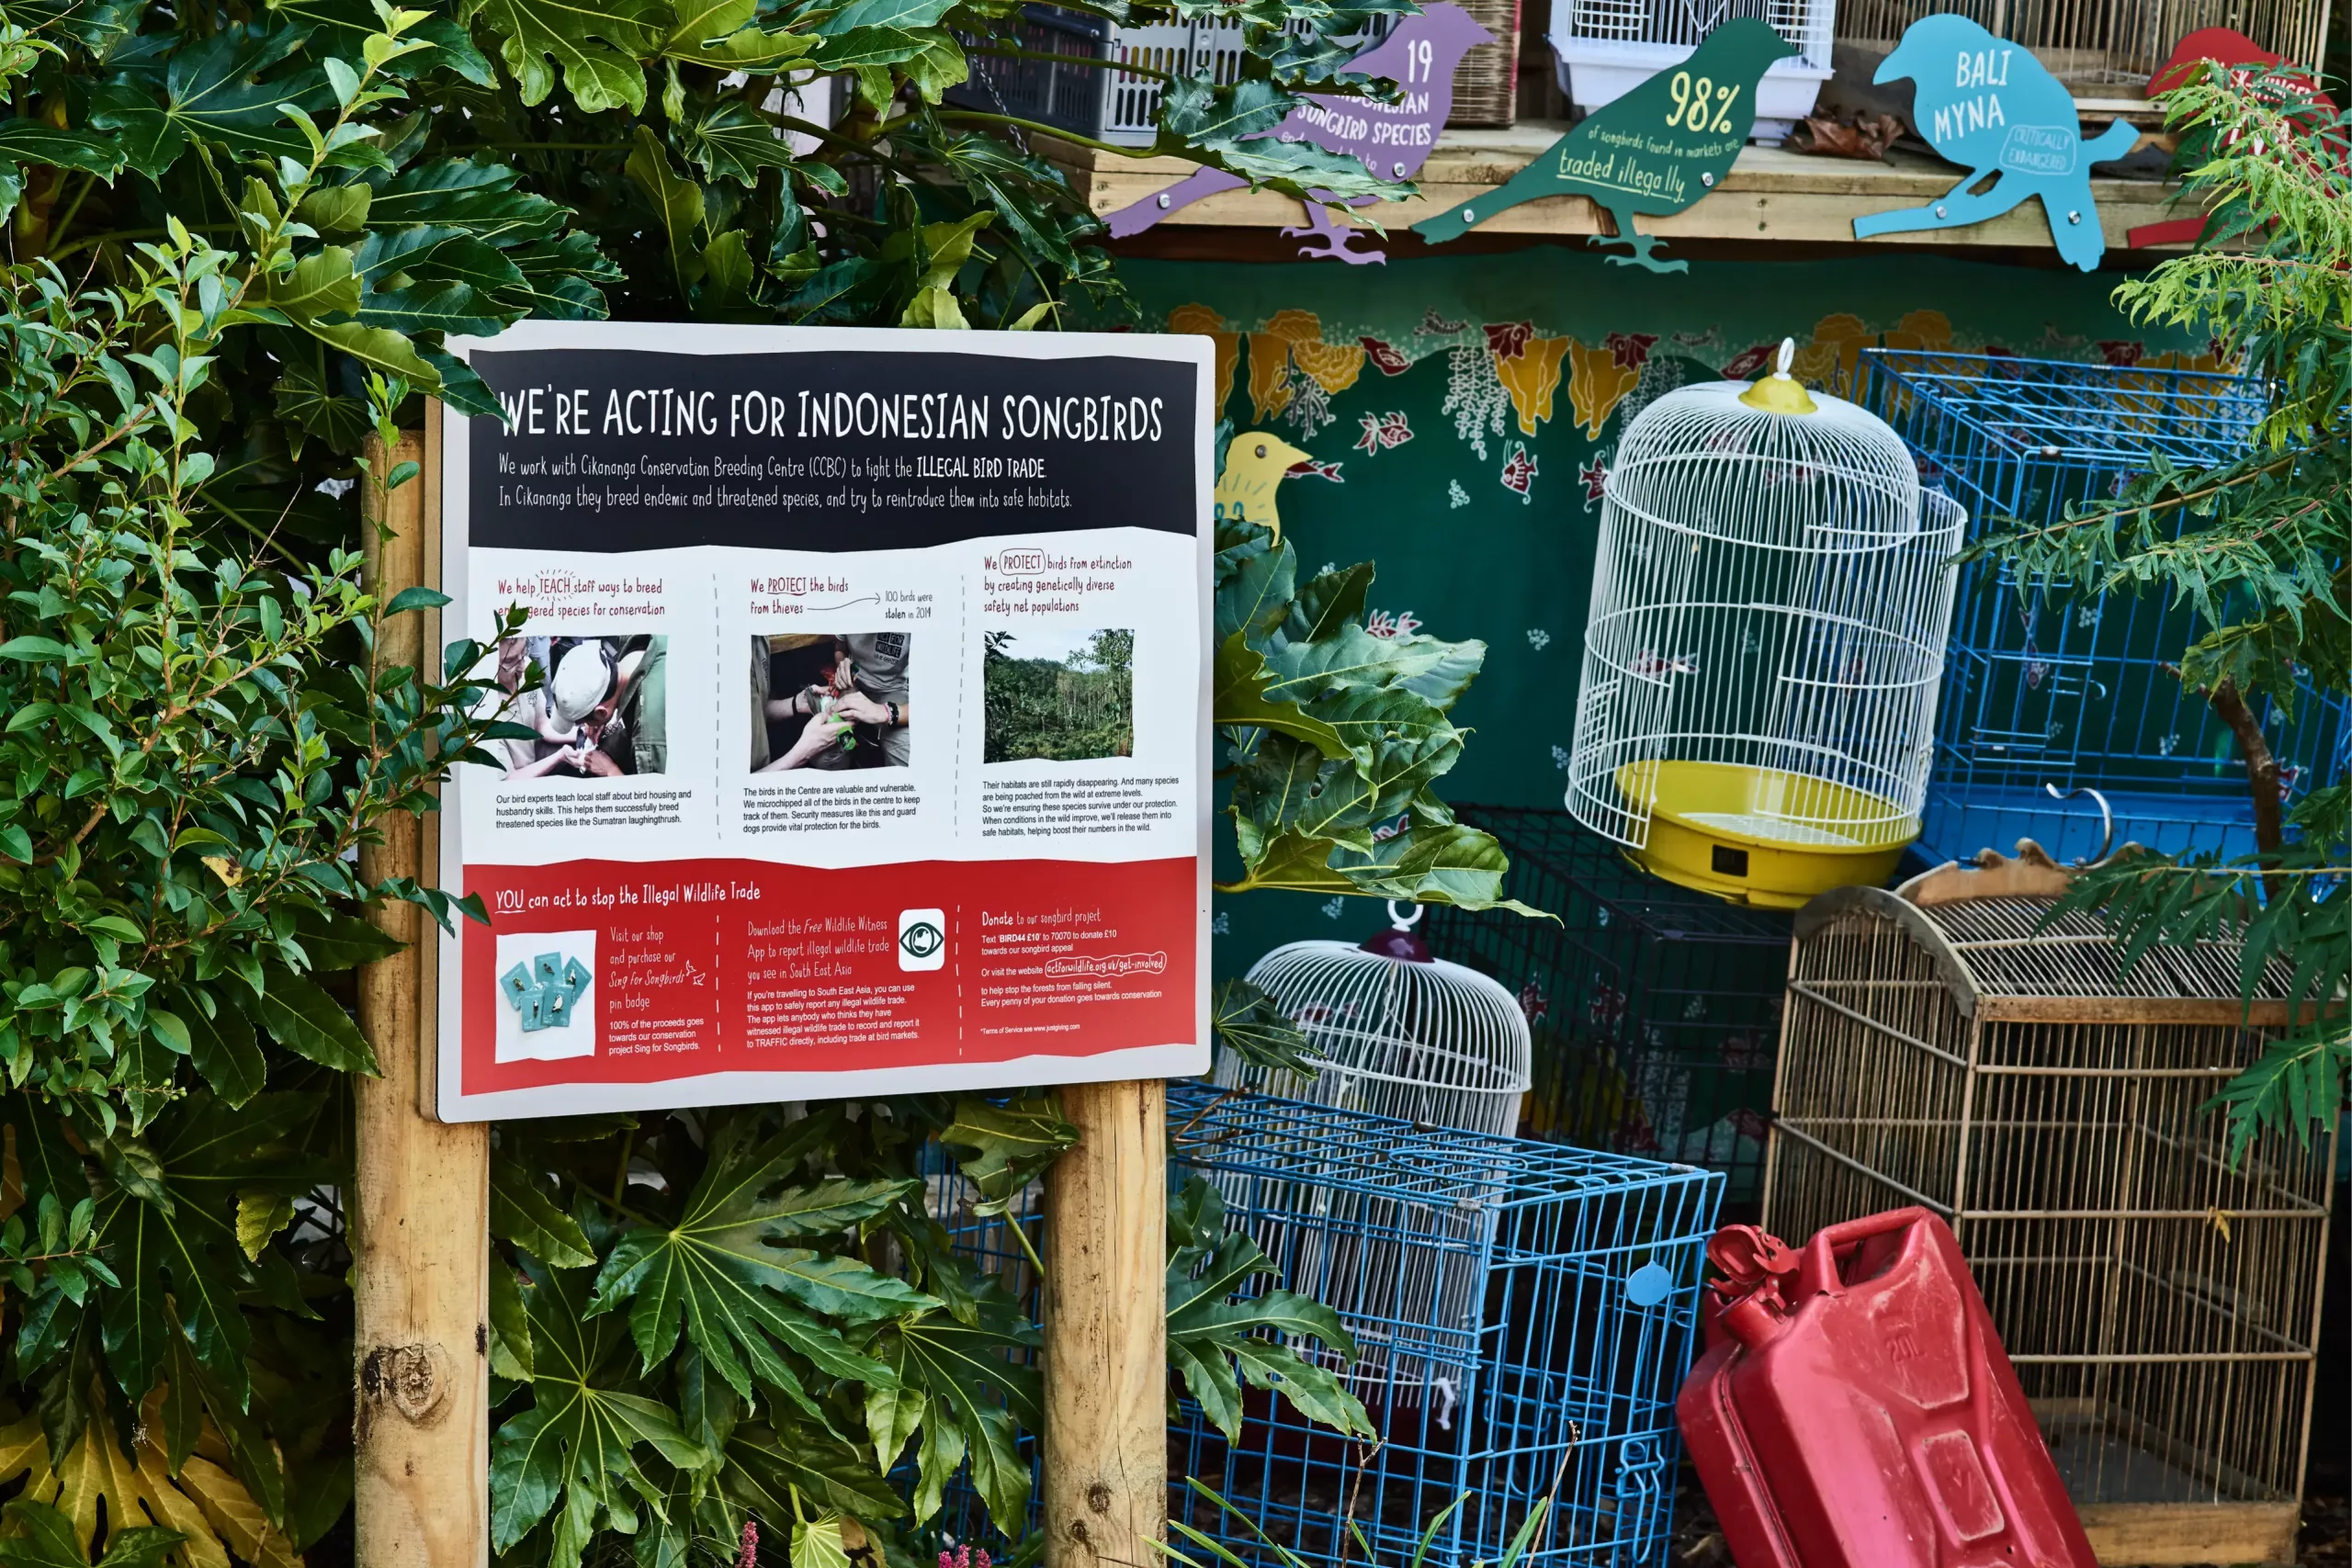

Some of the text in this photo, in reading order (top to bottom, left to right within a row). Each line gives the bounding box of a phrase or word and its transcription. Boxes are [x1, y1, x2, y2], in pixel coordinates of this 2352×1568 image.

[1407, 39, 1433, 84] 19
[1956, 49, 2012, 88] BALI
[1666, 71, 1740, 134] 98%
[1934, 93, 2006, 144] MYNA
[1372, 121, 1431, 147] SPECIES
[1588, 125, 1740, 158] of songbirds found in markets are
[1365, 152, 1378, 171] to
[1559, 147, 1615, 179] traded
[500, 384, 1163, 442] WE'RE ACTING FOR INDONESIAN SONGBIRDS
[499, 452, 515, 474] We
[520, 456, 548, 475] work
[551, 453, 576, 475] with
[581, 454, 636, 479] Cikananga
[640, 455, 709, 476] Conservation
[714, 455, 763, 480] Breeding
[767, 456, 804, 477] Centre
[808, 456, 846, 478] (CCBC)
[851, 457, 861, 477] to
[865, 456, 890, 481] fight
[895, 456, 911, 478] the
[916, 456, 969, 477] ILLEGAL
[973, 457, 1002, 478] BIRD
[499, 484, 1071, 513] In Cikananga they breed endemic and threatened species, and try to reintroduce them into safe habitats.
[984, 554, 1132, 570] We PROTECT birds from extinction
[498, 578, 662, 597] We help TEACH staff ways to breed
[751, 576, 848, 593] We PROTECT the birds
[984, 576, 1114, 595] by creating genetically diverse
[886, 591, 933, 602] 100 birds were
[498, 601, 664, 619] engered species for conservation
[751, 599, 803, 614] from thieves
[885, 607, 906, 619] stolen
[916, 606, 931, 618] 2014
[984, 598, 1079, 616] safety net populations
[496, 819, 534, 829] threatened
[536, 818, 563, 829] species
[565, 818, 577, 826] like
[579, 818, 590, 826] the
[593, 817, 627, 825] Sumatran
[743, 824, 760, 834] dogs
[762, 823, 786, 833] provide
[788, 822, 802, 830] vital
[804, 822, 837, 832] protection
[839, 821, 848, 829] for
[850, 820, 860, 829] the
[982, 828, 996, 836] safe
[1027, 827, 1050, 836] helping
[1053, 826, 1070, 834] boost
[1072, 825, 1086, 833] their
[1125, 823, 1135, 831] the
[496, 881, 761, 909] YOU can act to stop the Illegal Wildlife Trade
[748, 917, 888, 936] Download the Free Wildlife Witness
[981, 908, 1101, 926] Donate to our songbird project
[610, 925, 663, 944] Visit our shop
[610, 948, 676, 968] and purchase our
[747, 937, 889, 962] App to report illegal wildlife trade
[609, 970, 684, 989] Sing for Songbirds
[981, 968, 989, 976] Or
[991, 967, 1004, 976] visit
[1006, 967, 1016, 976] the
[1018, 966, 1044, 975] website
[609, 992, 650, 1013] pin badge
